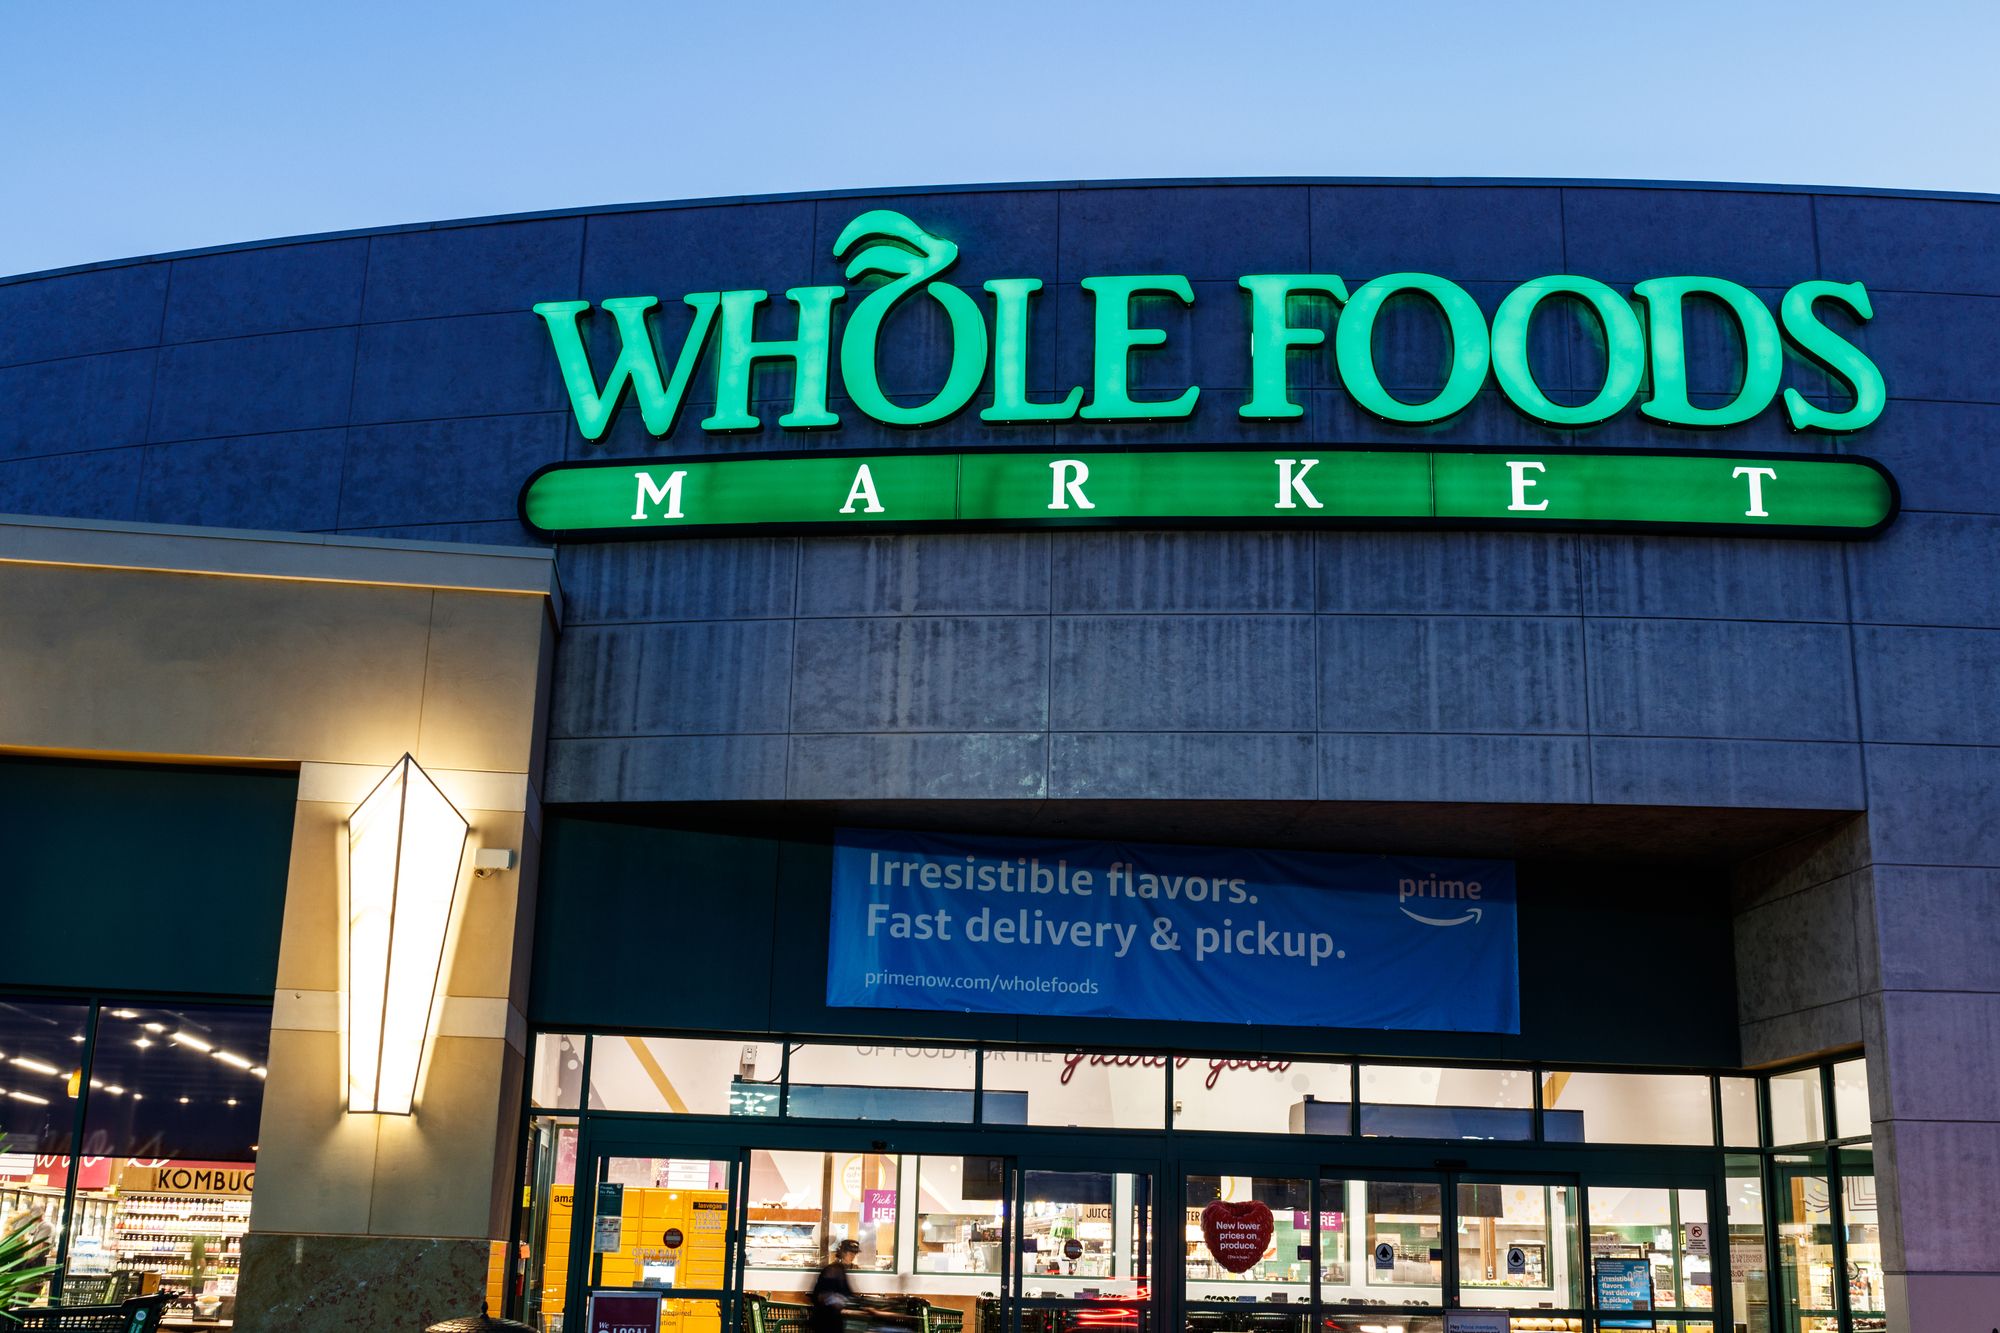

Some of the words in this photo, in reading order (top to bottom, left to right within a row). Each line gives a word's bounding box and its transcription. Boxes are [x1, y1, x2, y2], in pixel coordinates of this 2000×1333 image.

[532, 209, 1200, 443] WHOLE
[1238, 272, 1887, 434] FOODS
[630, 458, 1778, 520] MARKET
[868, 851, 1094, 898] Irresistible
[1106, 861, 1259, 906] flavors.
[1399, 873, 1483, 904] prime
[866, 902, 952, 940] Fast
[964, 907, 1137, 959] delivery
[1149, 916, 1182, 954] &
[1195, 918, 1347, 967] pickup.
[863, 967, 1100, 996] primenow.com/wholefoods
[1216, 1221, 1236, 1230] New
[1237, 1221, 1260, 1230] lower
[1303, 1214, 1336, 1227] HRE
[1219, 1231, 1245, 1241] prices
[1219, 1241, 1257, 1251] produce.
